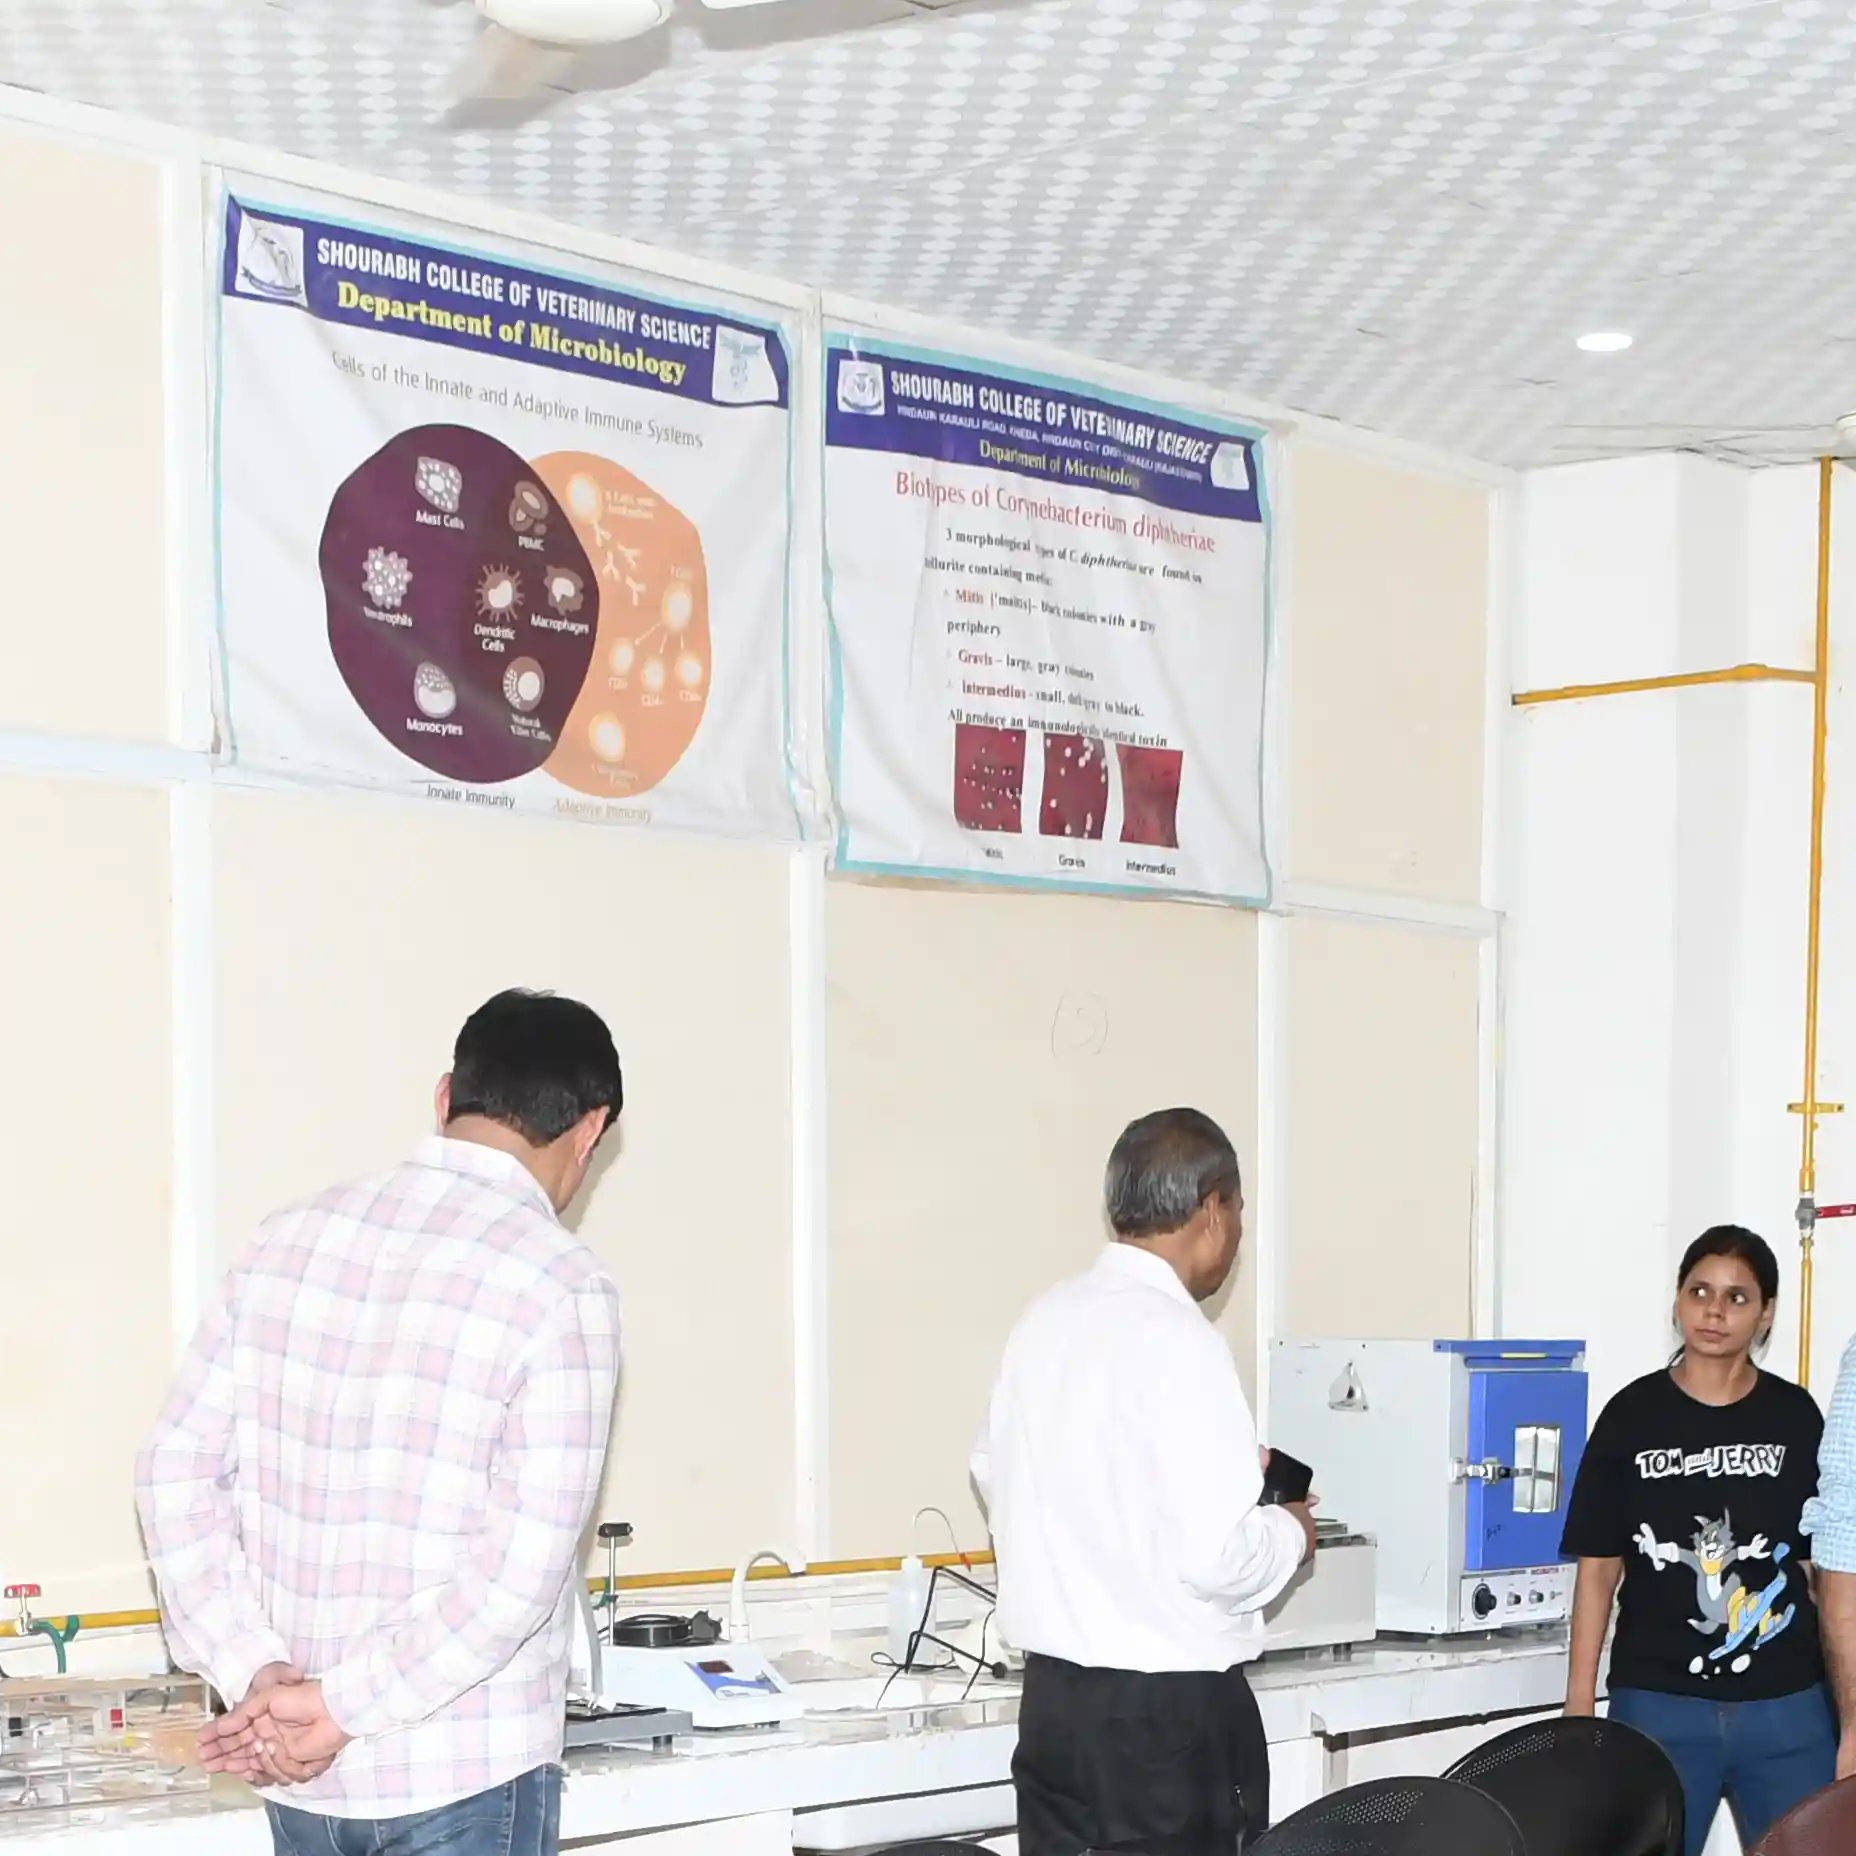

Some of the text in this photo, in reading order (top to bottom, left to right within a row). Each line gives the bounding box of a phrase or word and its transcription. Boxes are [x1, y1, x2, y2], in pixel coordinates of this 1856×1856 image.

[317, 238, 711, 350] SHOURABH COLLEGE OF VETERINARY SCIENCE
[338, 281, 686, 386] Department of Microbiology
[332, 351, 703, 448] Cells of the Innate and Adaptive Immune Systems
[891, 371, 1213, 464] SHOURABH COLLEGE OF VETERINARY SCIENCE
[980, 439, 1047, 471] Department
[1049, 458, 1061, 473] of
[415, 509, 465, 530] Mast Cells
[896, 471, 1216, 553] Biotypes of Corynebacterium diphtheriae
[474, 624, 516, 640] Dendritic
[531, 614, 589, 635] Macrophages
[947, 619, 1001, 638] periphery
[482, 638, 505, 653] Cells
[962, 679, 1026, 700] Intermedius
[406, 718, 464, 737] Monocytes
[948, 708, 962, 722] All
[1010, 716, 1024, 729] an
[427, 784, 515, 809] Innate Immunity
[1635, 1448, 1684, 1479] TOM
[1708, 1444, 1787, 1478] JERRY
